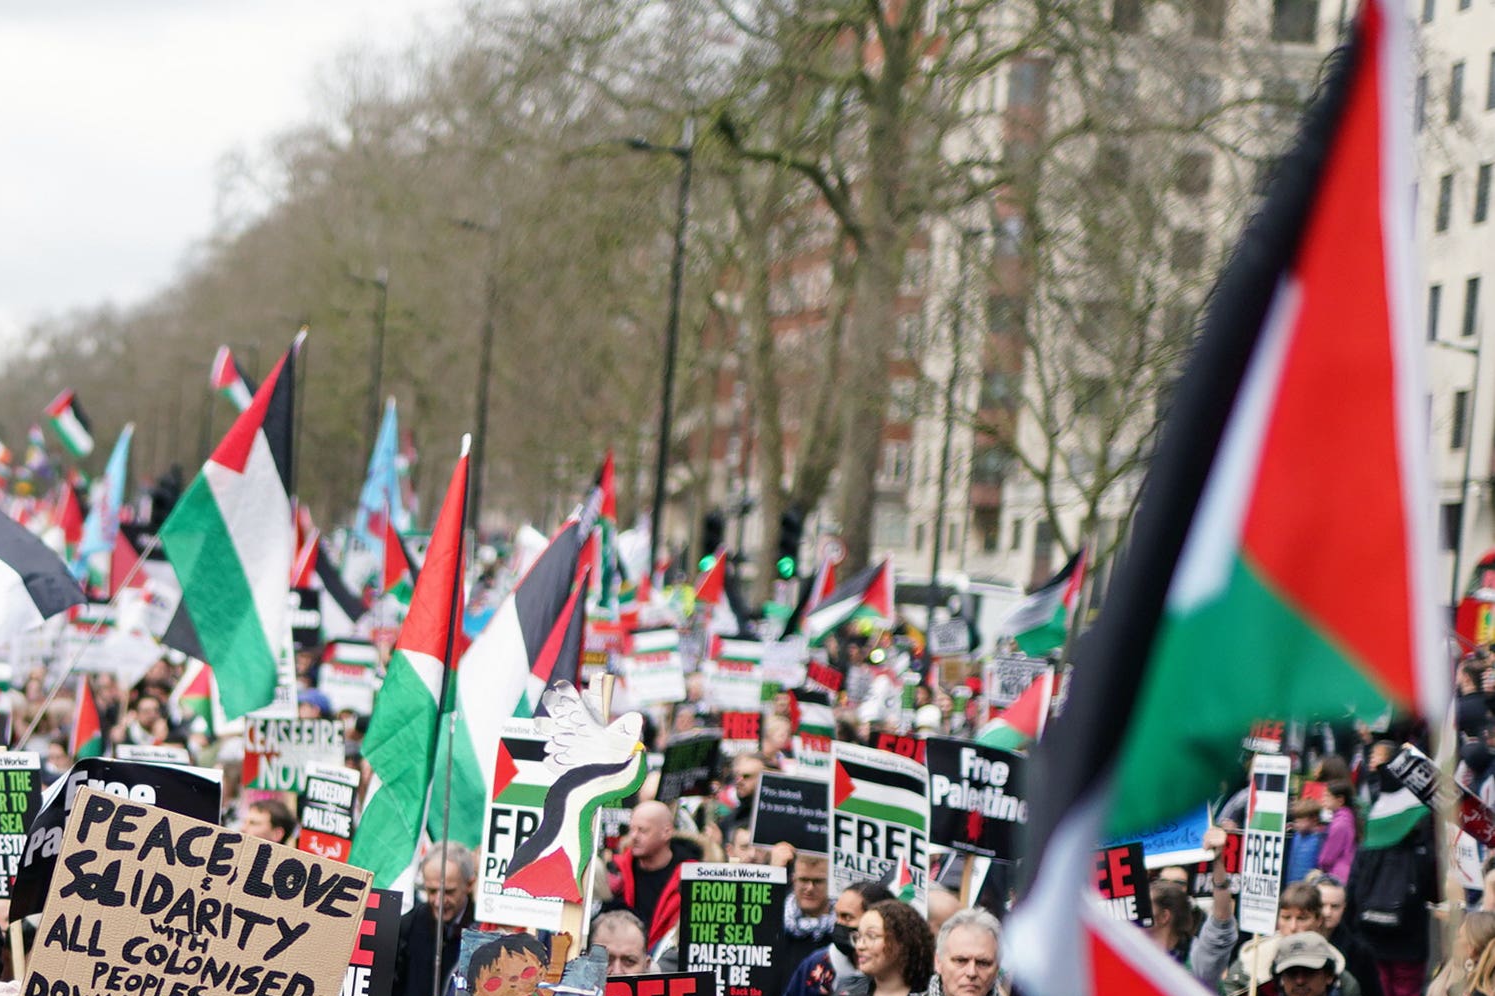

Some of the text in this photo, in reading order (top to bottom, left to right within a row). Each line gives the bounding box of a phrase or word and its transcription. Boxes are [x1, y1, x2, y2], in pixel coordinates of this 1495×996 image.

[245, 718, 346, 752] CEASEFIRE
[3, 756, 29, 767] Worker
[961, 747, 1010, 787] Free
[9, 770, 32, 791] THE
[10, 792, 28, 812] TO
[0, 813, 25, 833] SEA
[833, 813, 927, 872] FREE
[1246, 832, 1282, 876] FREE
[77, 794, 367, 918] PEACE, LOVE
[697, 867, 772, 880] Socialist Worker
[692, 881, 773, 905] FROM THE
[1242, 874, 1279, 898] PALESTINE
[60, 849, 310, 961] SOLIDARITY
[690, 902, 763, 925] RIVER TO
[44, 913, 105, 957] ALL
[149, 918, 208, 954] WITH
[690, 923, 754, 945] THE SEA
[687, 943, 773, 968] PALESTINE
[729, 965, 751, 987] BE
[729, 987, 763, 996] Back the
